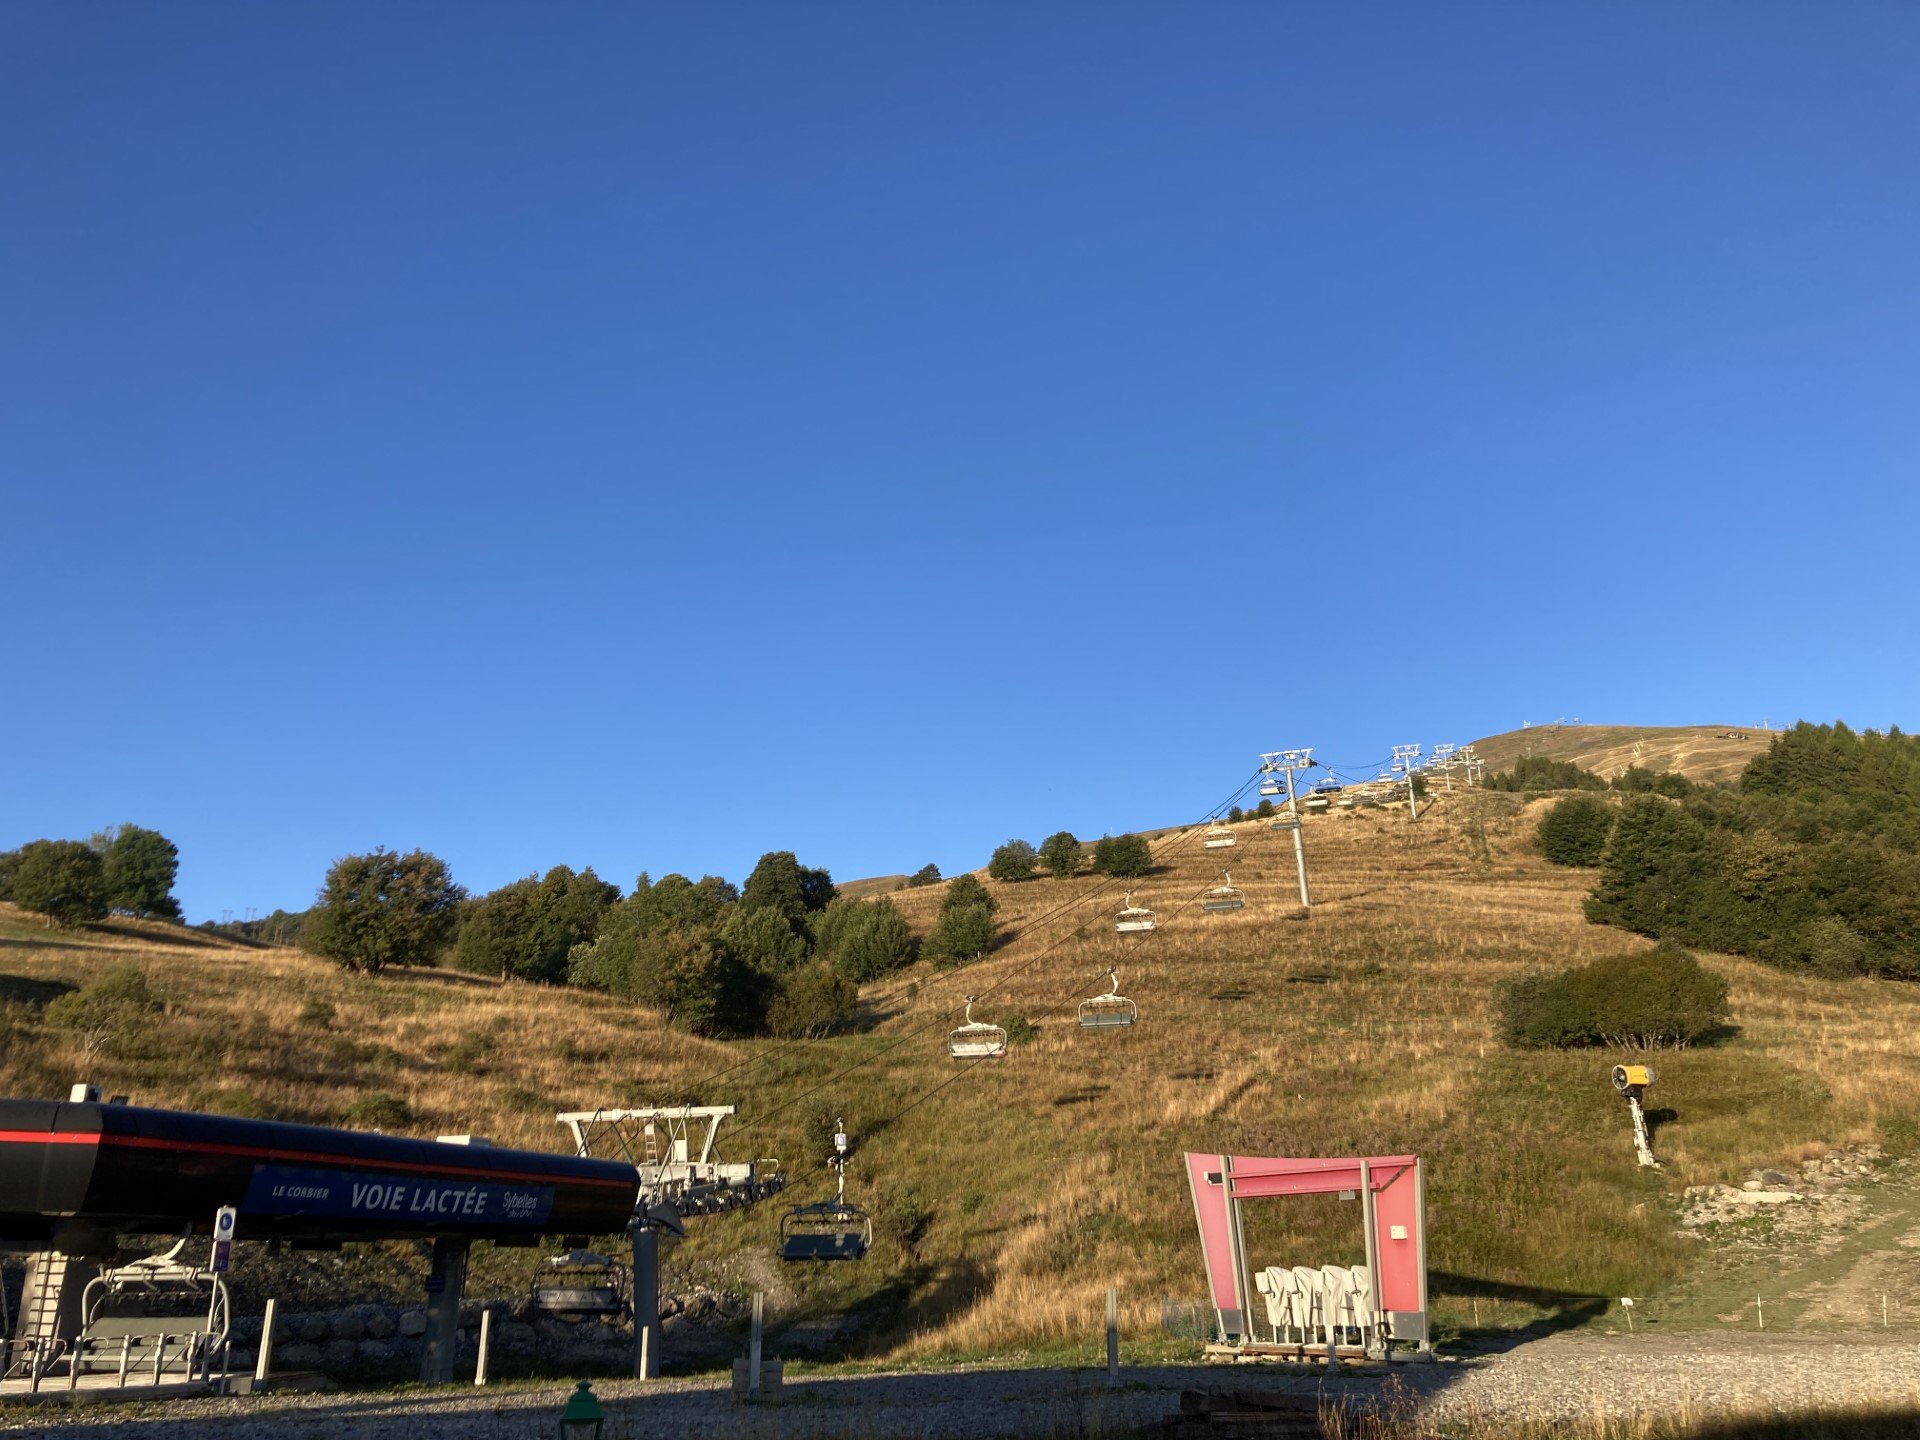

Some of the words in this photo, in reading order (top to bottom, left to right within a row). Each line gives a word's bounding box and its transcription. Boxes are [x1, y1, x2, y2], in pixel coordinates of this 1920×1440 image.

[272, 1185, 286, 1197] LE
[287, 1186, 330, 1199] CORBIER
[351, 1183, 406, 1211] VOIE
[410, 1185, 489, 1215] LACTÉE
[502, 1191, 538, 1212] Sybelles
